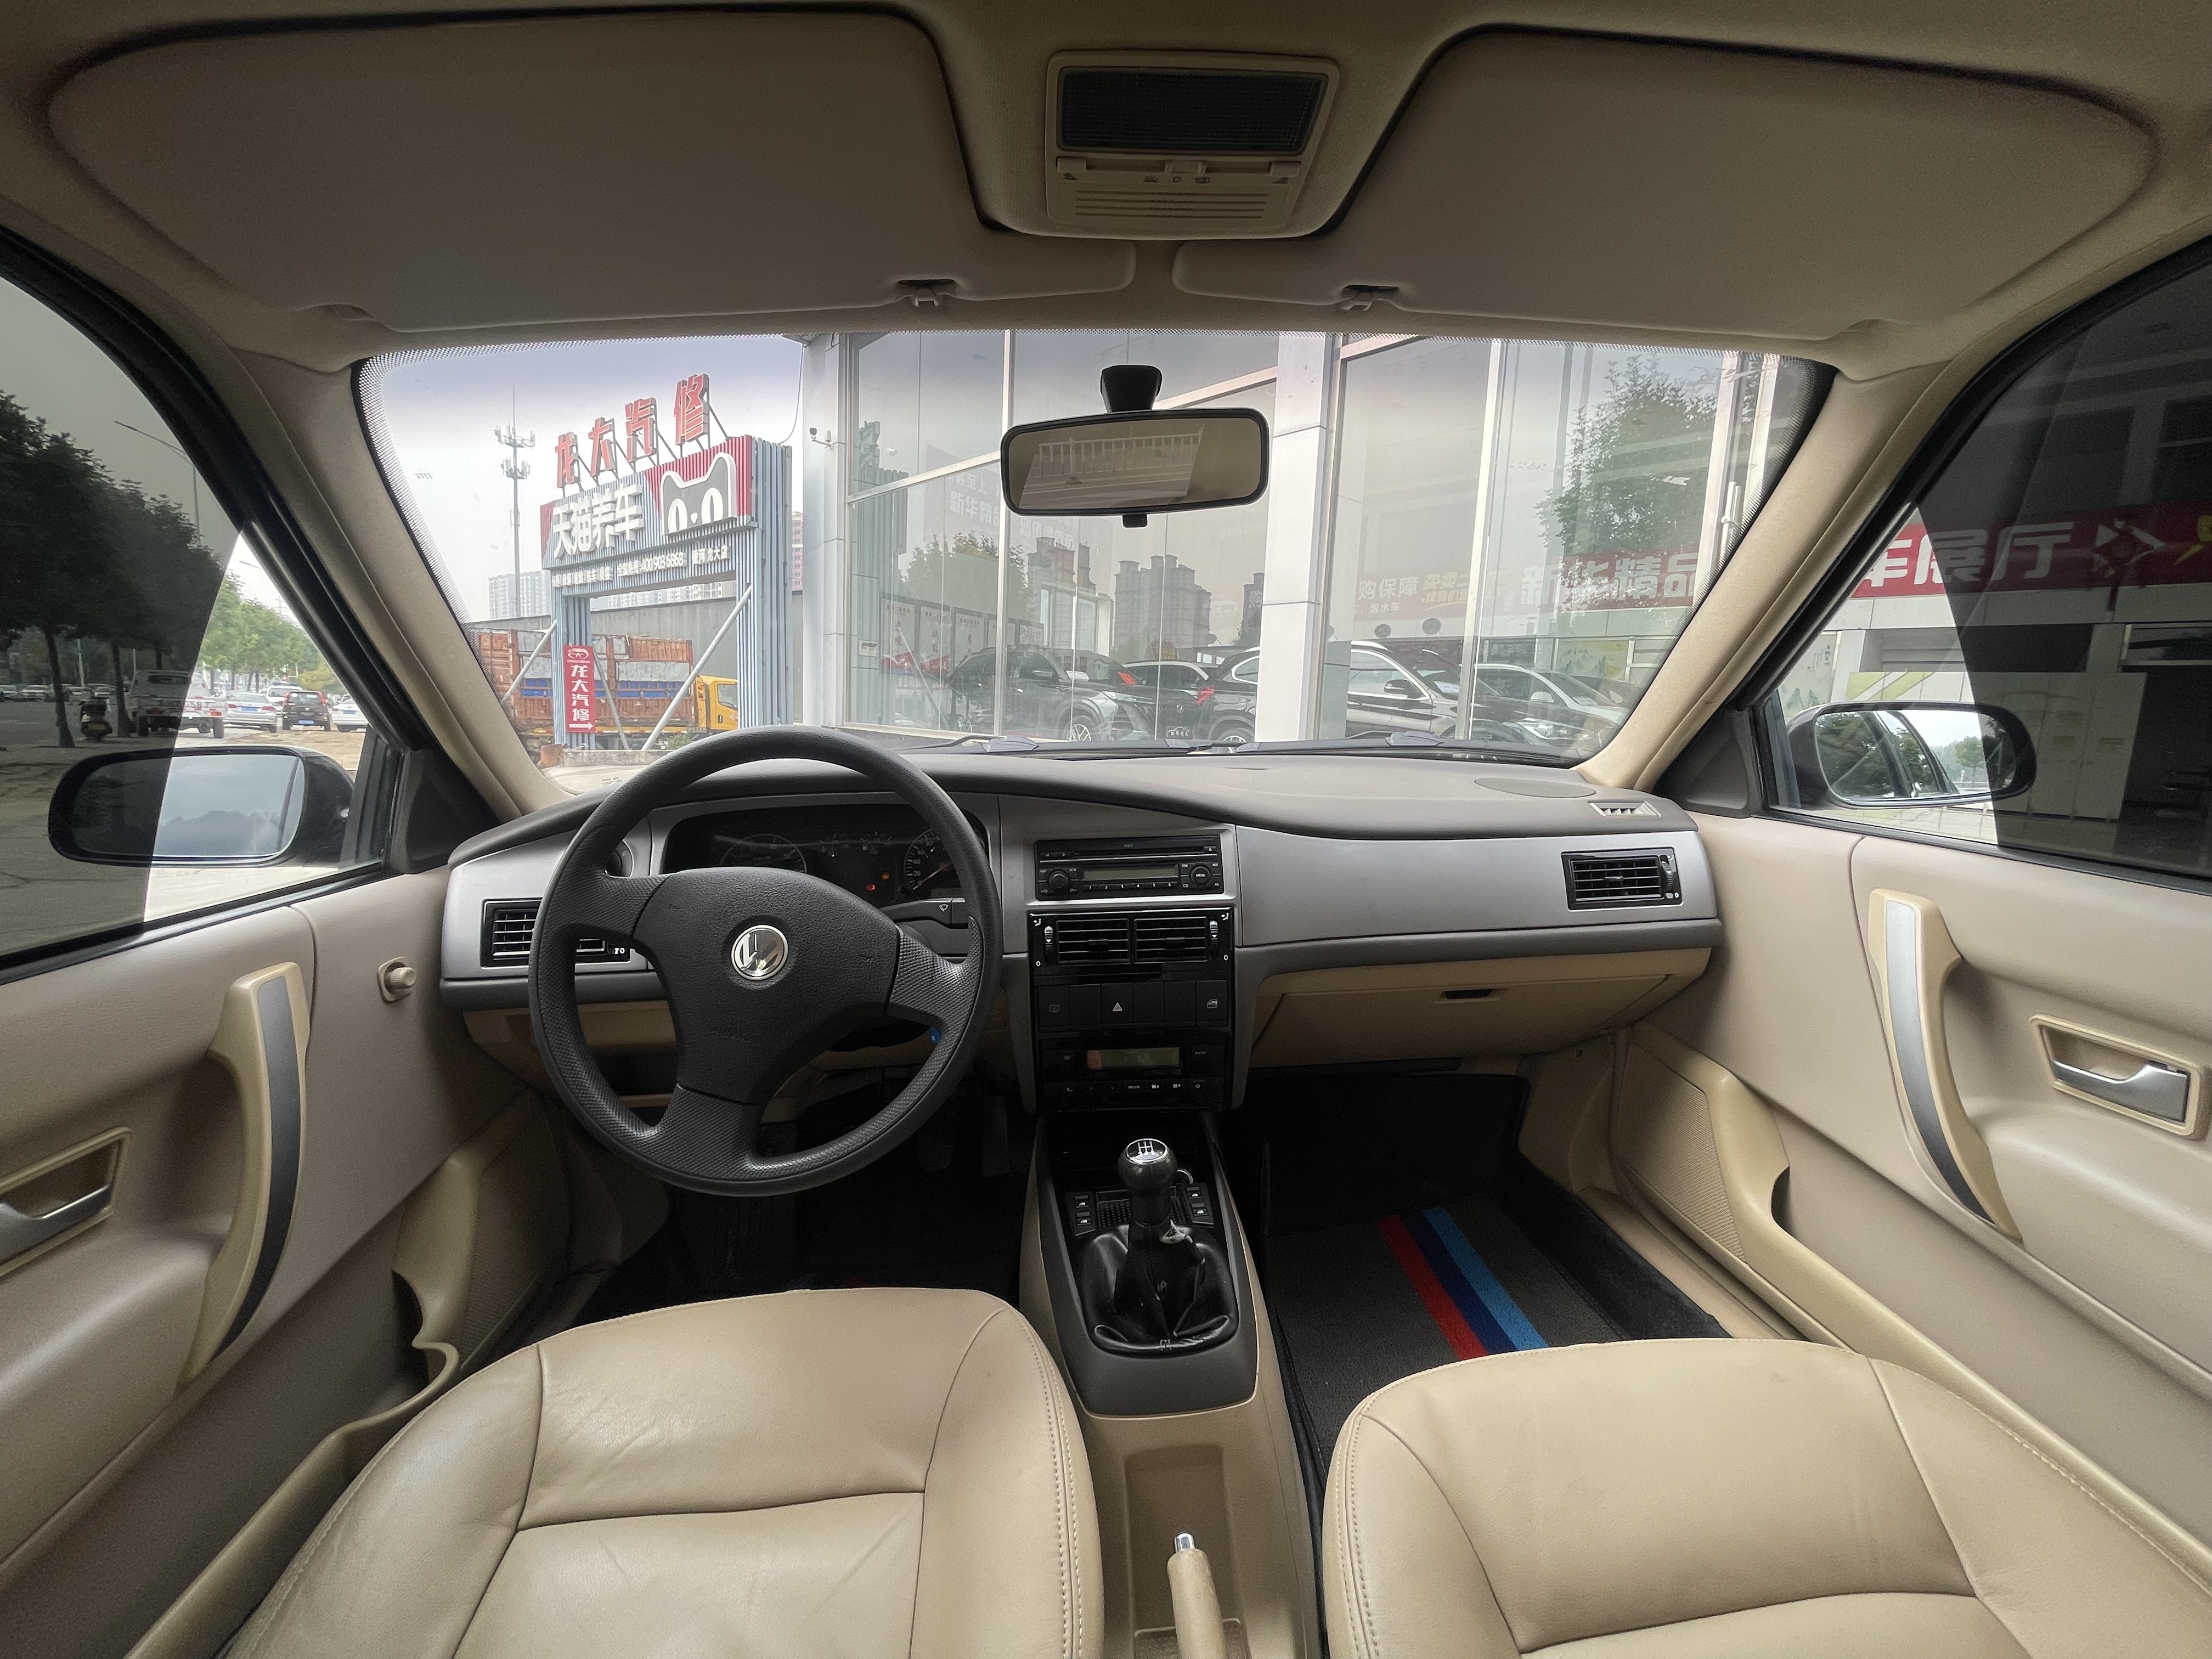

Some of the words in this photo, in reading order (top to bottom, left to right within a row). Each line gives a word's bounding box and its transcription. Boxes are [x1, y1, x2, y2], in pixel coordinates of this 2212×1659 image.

[555, 374, 709, 489] 龙大汽修
[552, 483, 643, 559] 天猫养车
[1865, 521, 2074, 588] 车展厅
[653, 555, 666, 571] 903
[667, 551, 684, 568] 6868
[570, 664, 590, 721] 龙大汽修
